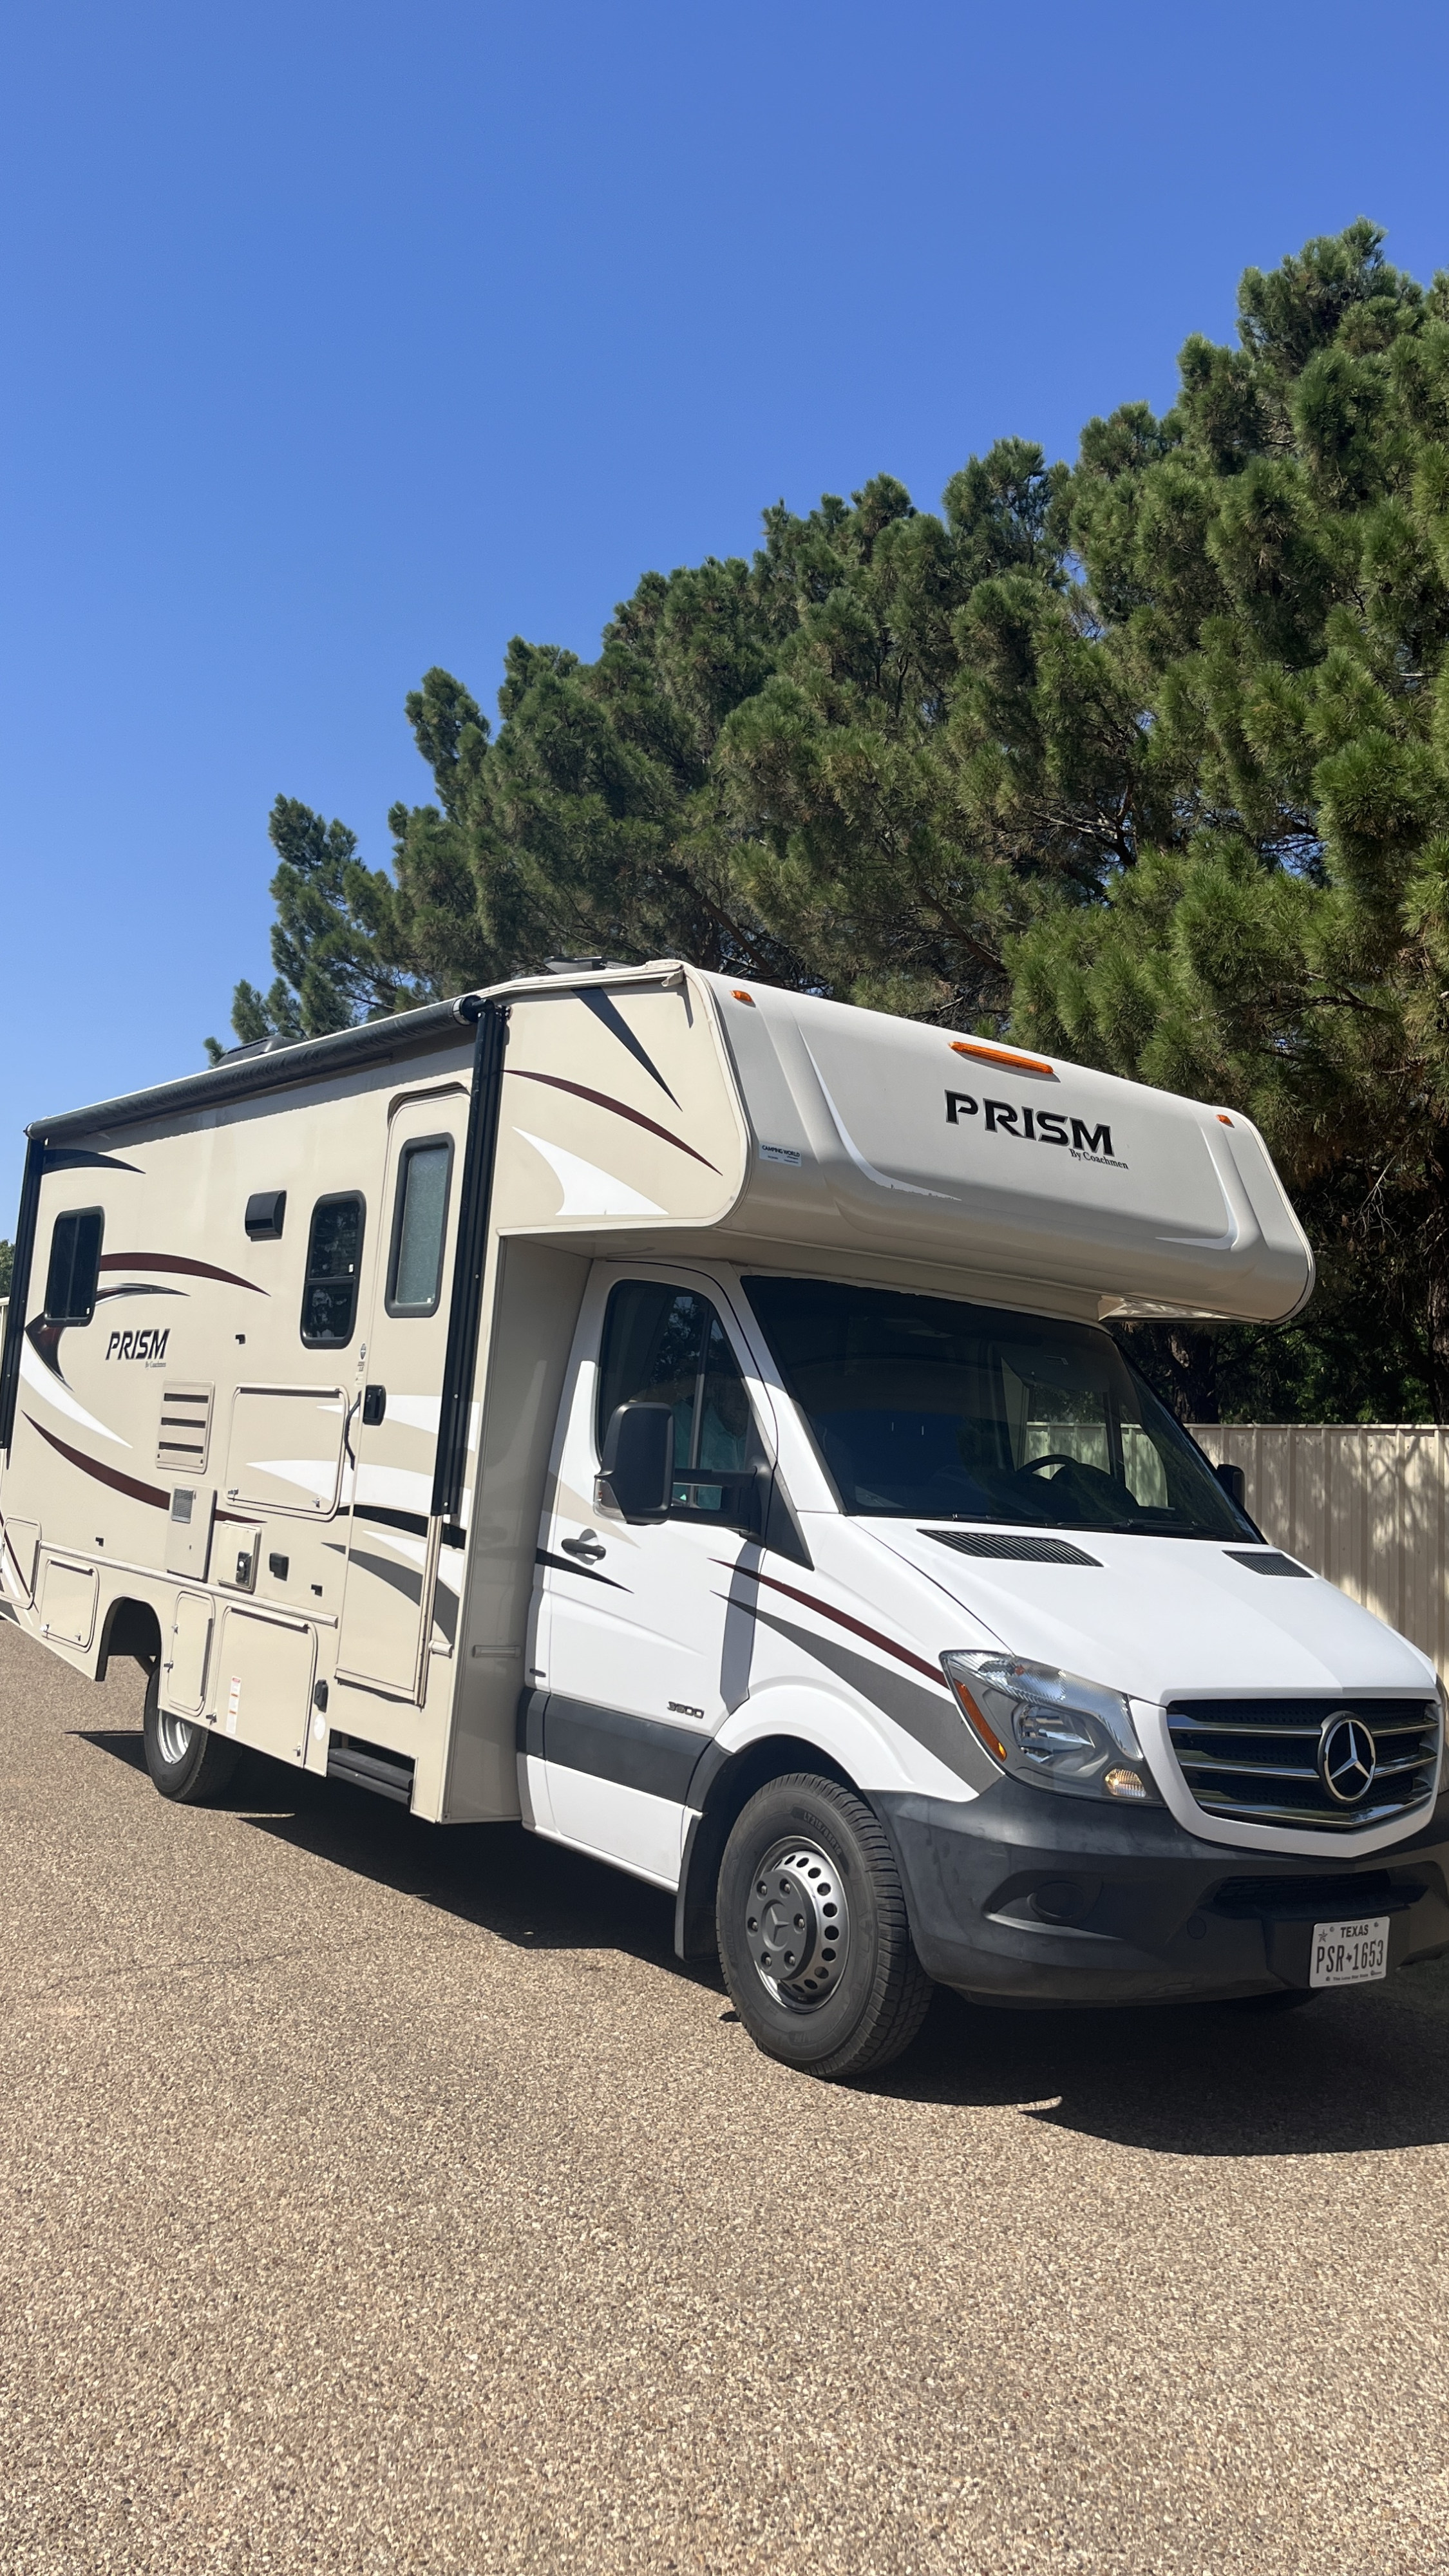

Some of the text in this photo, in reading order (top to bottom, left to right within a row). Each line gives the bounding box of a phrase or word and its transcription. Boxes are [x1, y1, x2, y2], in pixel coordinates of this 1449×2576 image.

[944, 1089, 1115, 1157] PRISM
[762, 1145, 783, 1154] CAMPING
[1069, 1148, 1130, 1170] By Coachmen
[105, 1328, 171, 1360] PRISM
[1340, 1924, 1369, 1938] TEXAS
